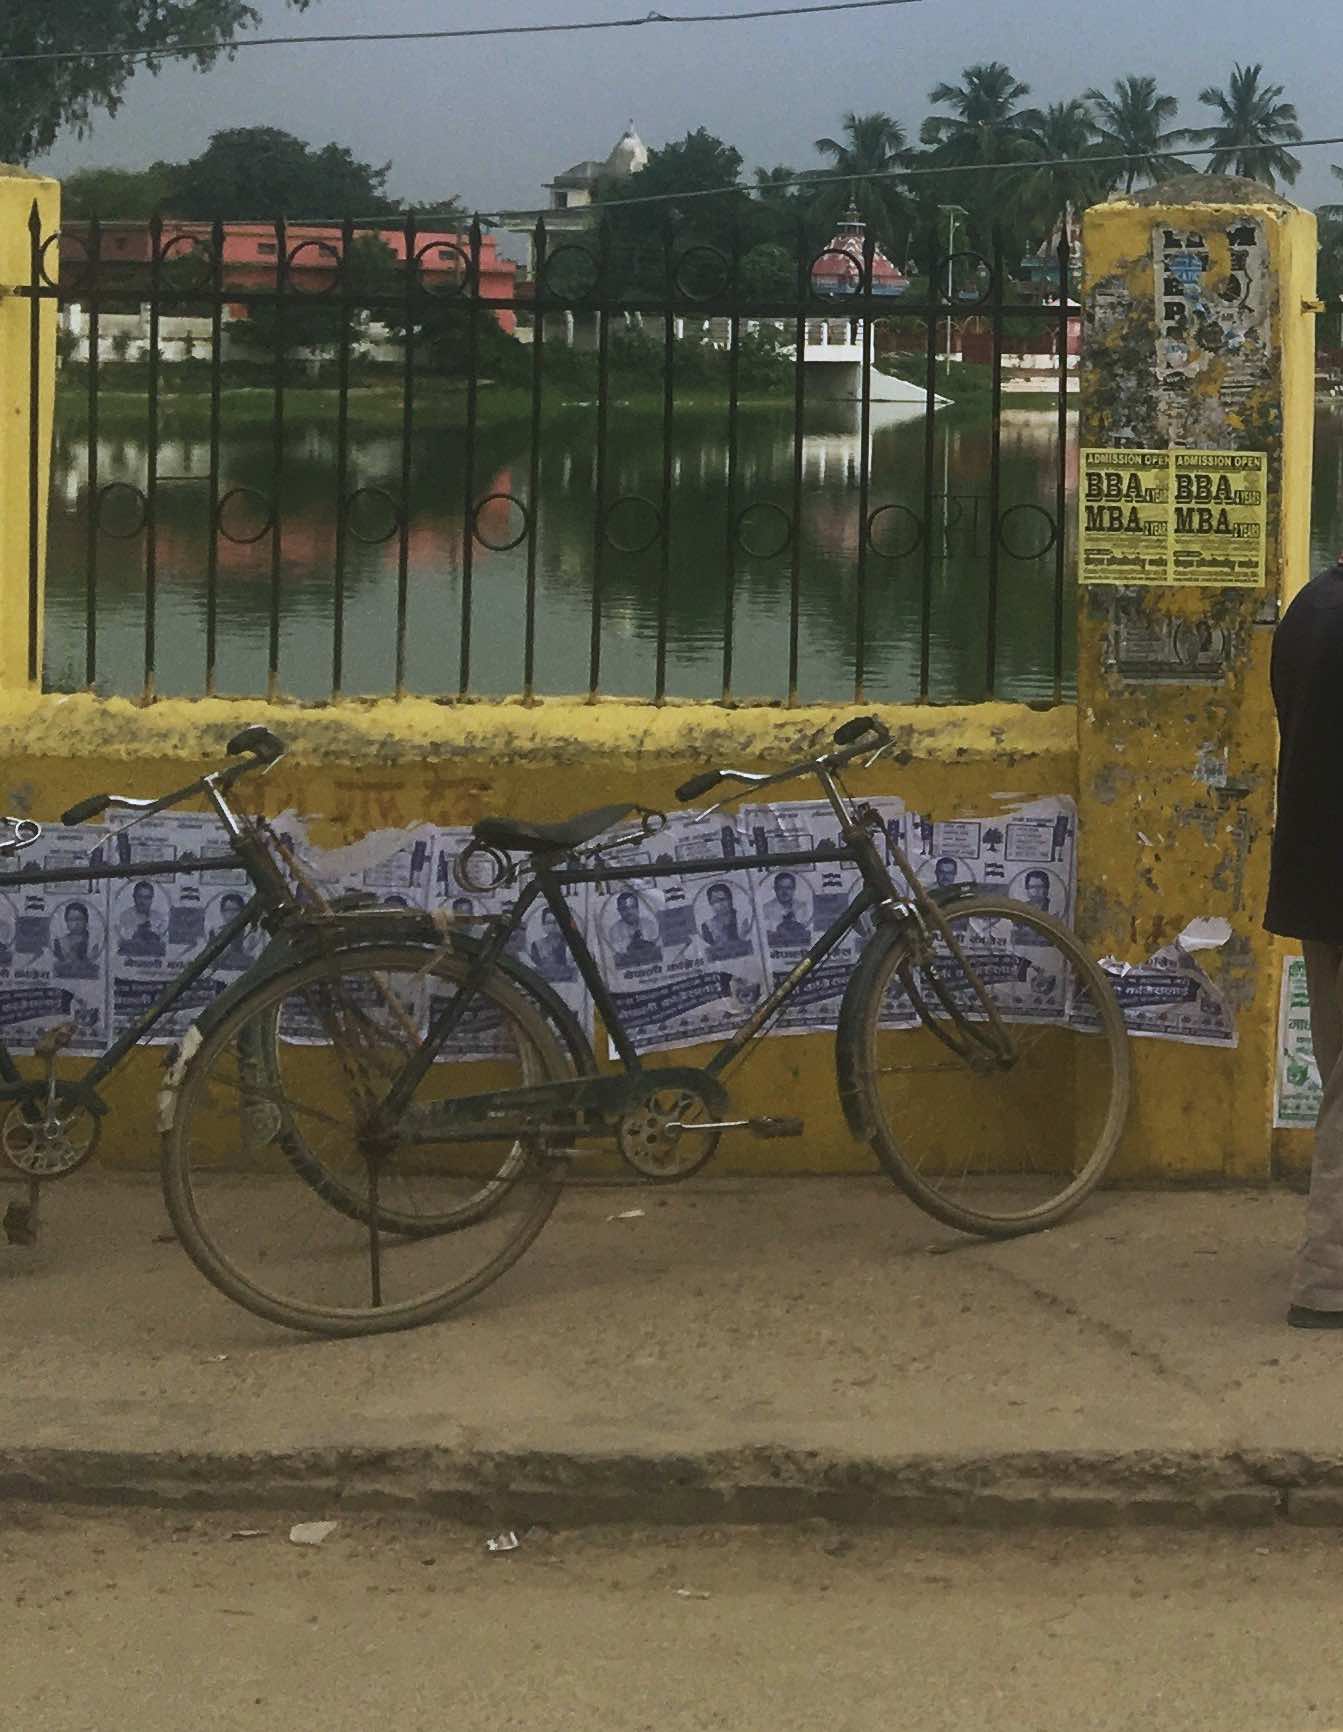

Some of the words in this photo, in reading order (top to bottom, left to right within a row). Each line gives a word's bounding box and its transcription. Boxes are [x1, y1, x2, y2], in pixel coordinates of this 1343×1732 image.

[1087, 454, 1142, 465] ADMISSION
[1176, 456, 1231, 466] ADMISSION
[1234, 456, 1261, 467] OPEN
[1085, 472, 1144, 503] BBA
[1175, 473, 1233, 504] BBA
[1085, 505, 1143, 534] MBA
[1174, 507, 1232, 535] MBA
